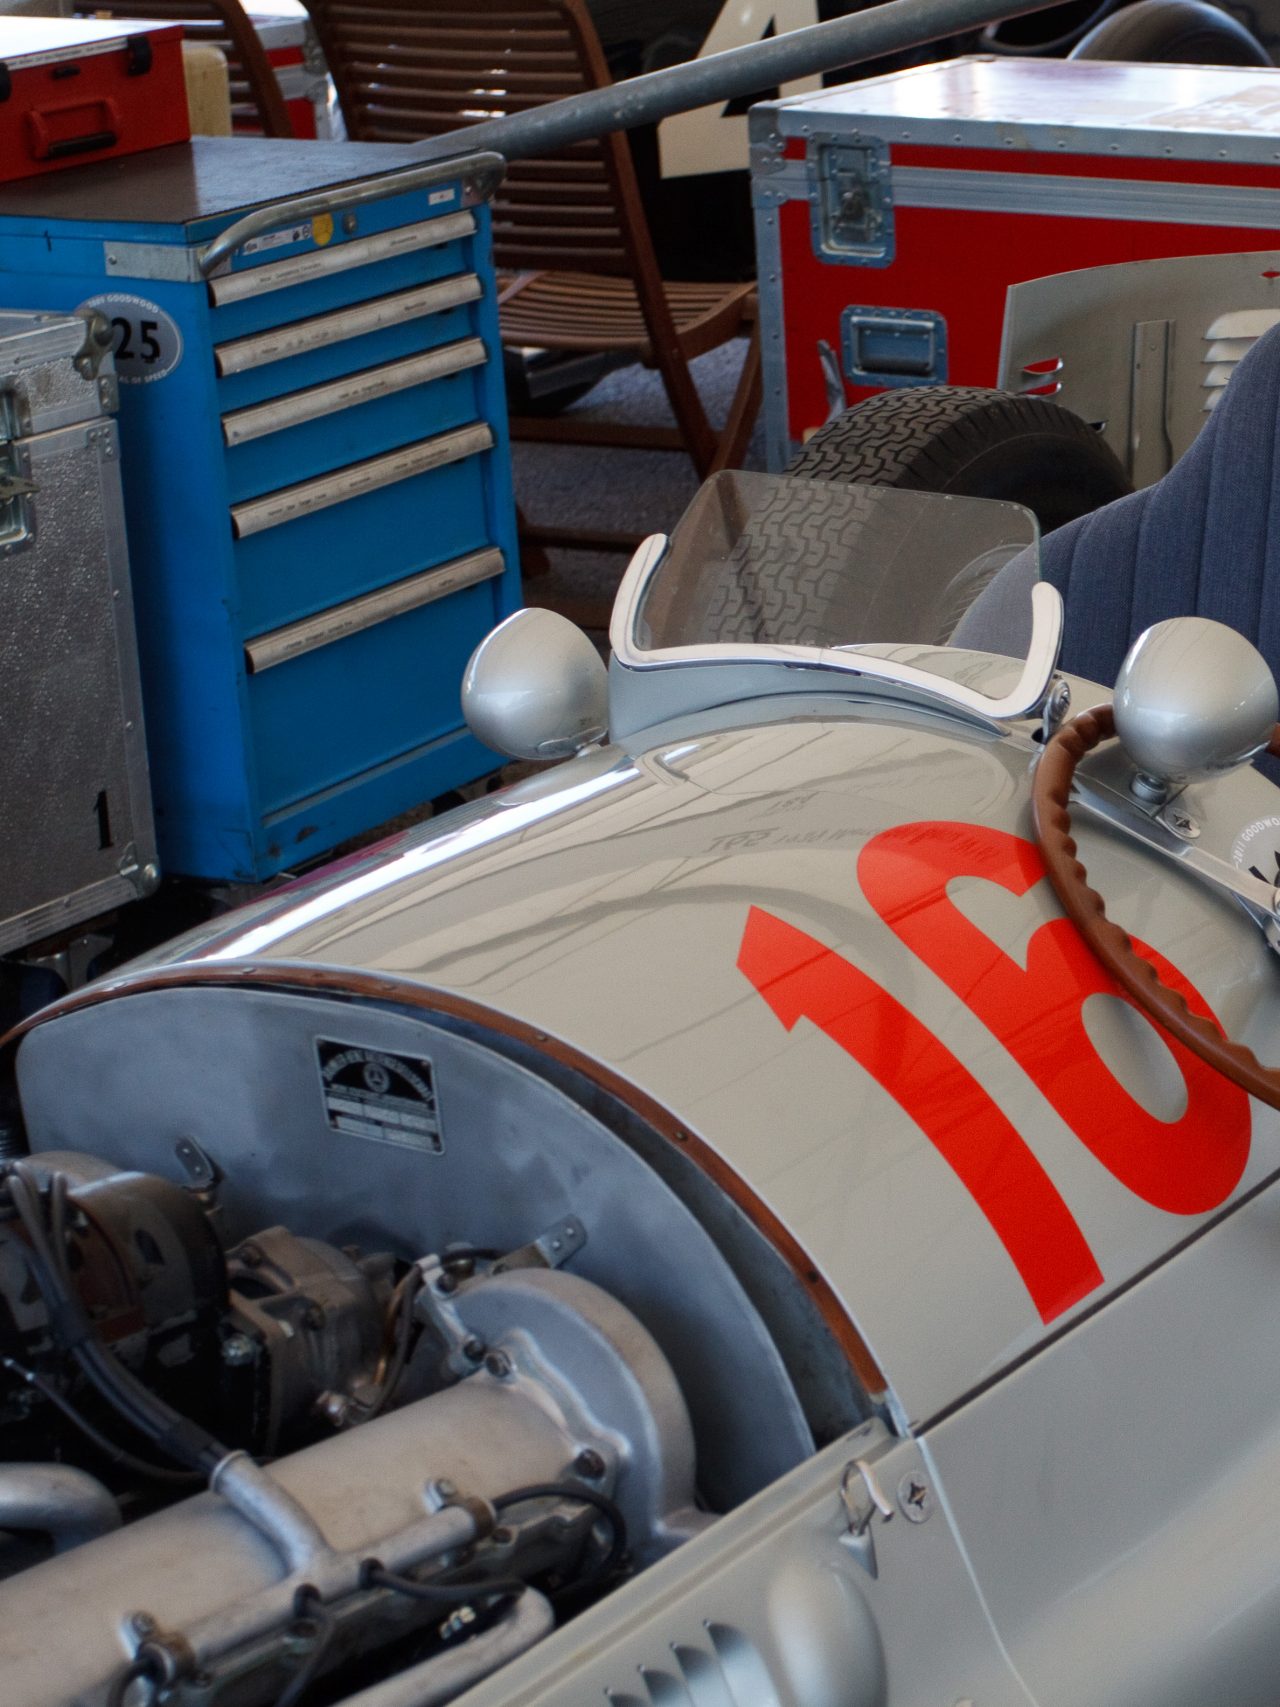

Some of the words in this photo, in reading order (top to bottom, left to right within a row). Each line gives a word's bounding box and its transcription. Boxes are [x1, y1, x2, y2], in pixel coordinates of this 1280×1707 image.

[106, 294, 159, 314] GOODWOOD
[93, 790, 114, 852] 1
[736, 820, 1252, 1326] 16
